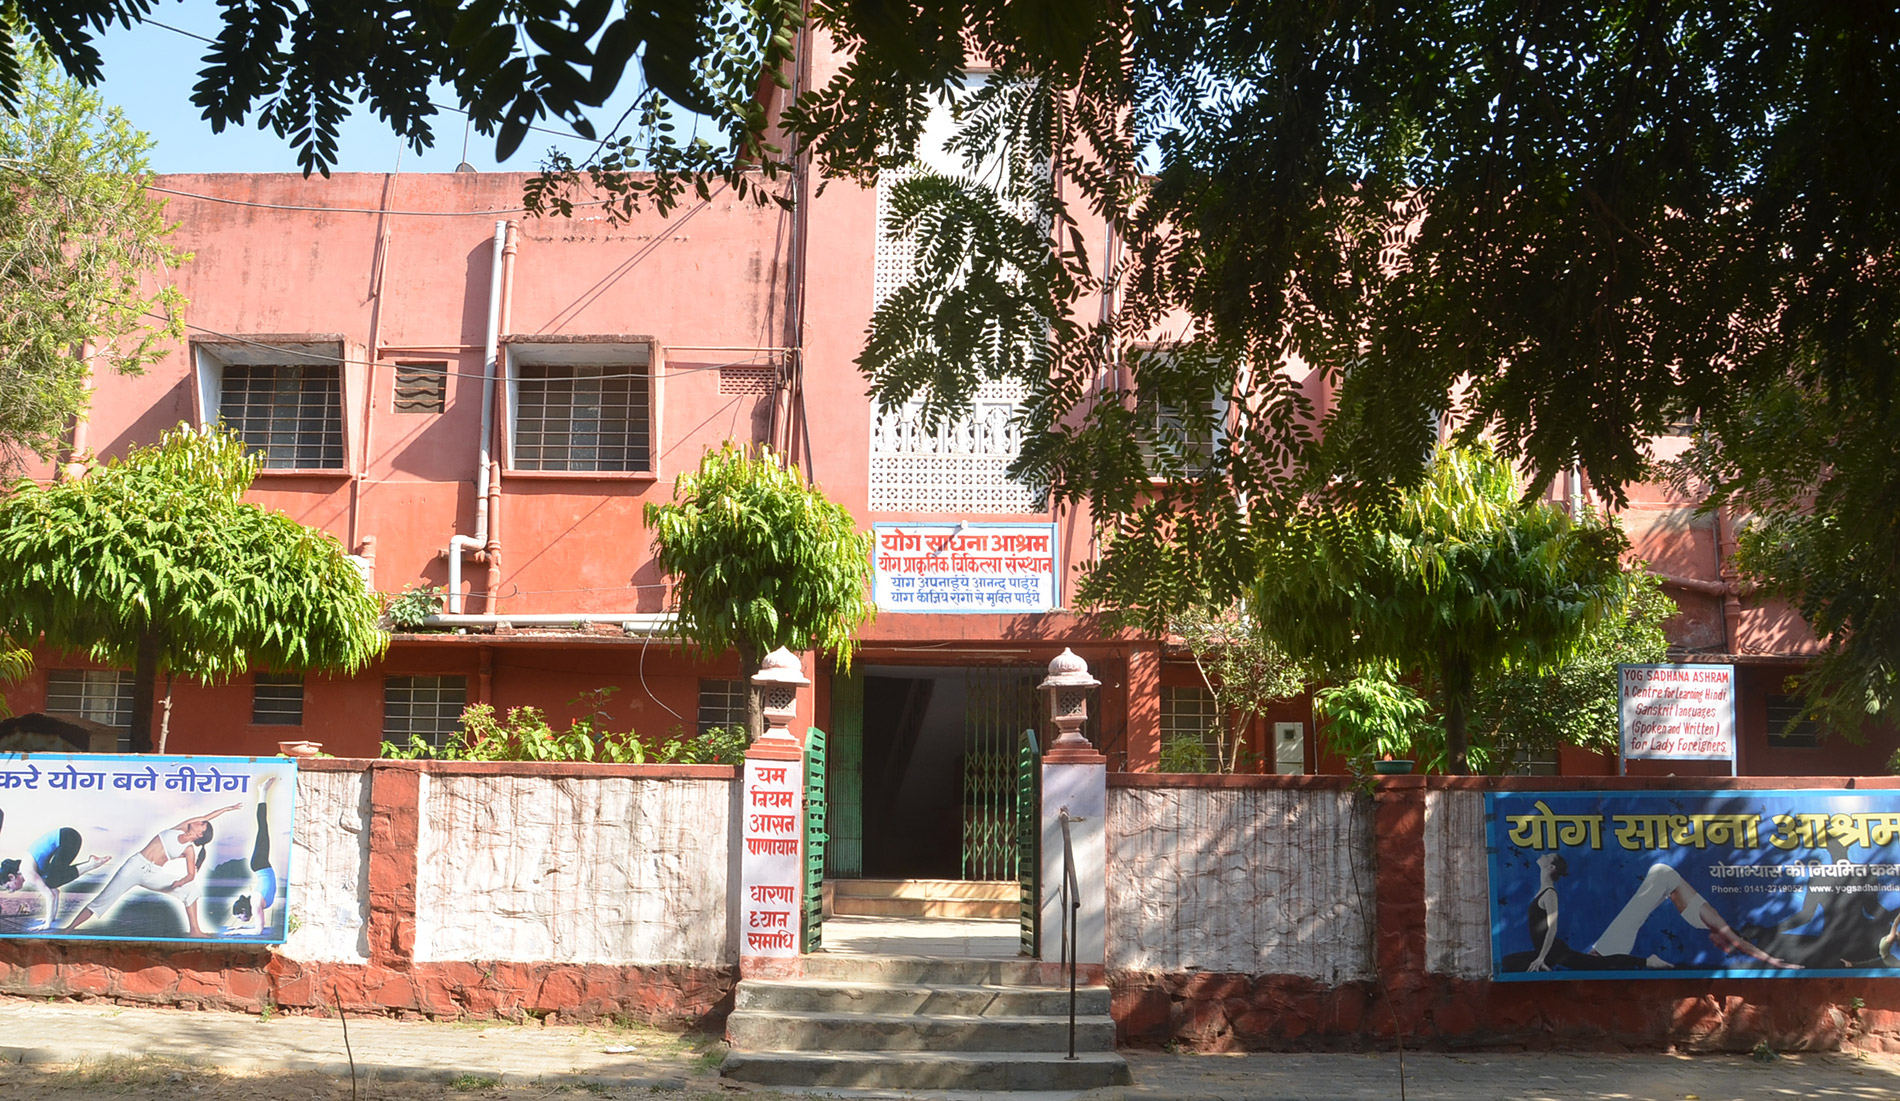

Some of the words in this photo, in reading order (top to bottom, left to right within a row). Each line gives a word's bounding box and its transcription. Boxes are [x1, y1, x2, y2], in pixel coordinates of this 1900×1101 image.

[881, 527, 921, 551] योग
[924, 535, 988, 552] साधना
[991, 534, 1049, 552] आश्रम
[878, 552, 901, 572] योग
[903, 552, 949, 576] प्राकृतिक
[951, 552, 1003, 574] चिकित्सा
[1004, 553, 1053, 575] संस्थान
[890, 574, 915, 588] योग
[972, 577, 1006, 590] आनन्द
[890, 588, 914, 603] योग
[974, 589, 984, 605] से
[986, 589, 1012, 607] मुक्ति
[1623, 669, 1643, 681] YOG
[1646, 670, 1689, 682] SADHANA
[1692, 671, 1729, 683] ASHRAM
[1624, 685, 1629, 698] A
[1632, 685, 1663, 699] Centre
[1664, 687, 1675, 699] for
[1635, 703, 1674, 717] Sanskrit
[1632, 720, 1667, 737] (Spoken
[1667, 722, 1681, 735] and
[1630, 737, 1648, 751] for
[1650, 738, 1675, 753] Lady
[0, 764, 42, 789] करे
[48, 764, 107, 790] योग
[113, 766, 159, 791] बने
[165, 766, 251, 793] नीरोग
[755, 767, 787, 784] यम
[750, 785, 794, 808] नियम
[749, 814, 796, 835] आसन
[1506, 801, 1603, 849] योग
[1612, 814, 1760, 849] साधना
[1709, 861, 1782, 878] योगाभ्यास
[1784, 860, 1805, 878] की
[1808, 859, 1867, 877] नियमित
[750, 886, 795, 904] धारणा
[1711, 885, 1742, 893] Phone:
[746, 930, 794, 951] समाधि
